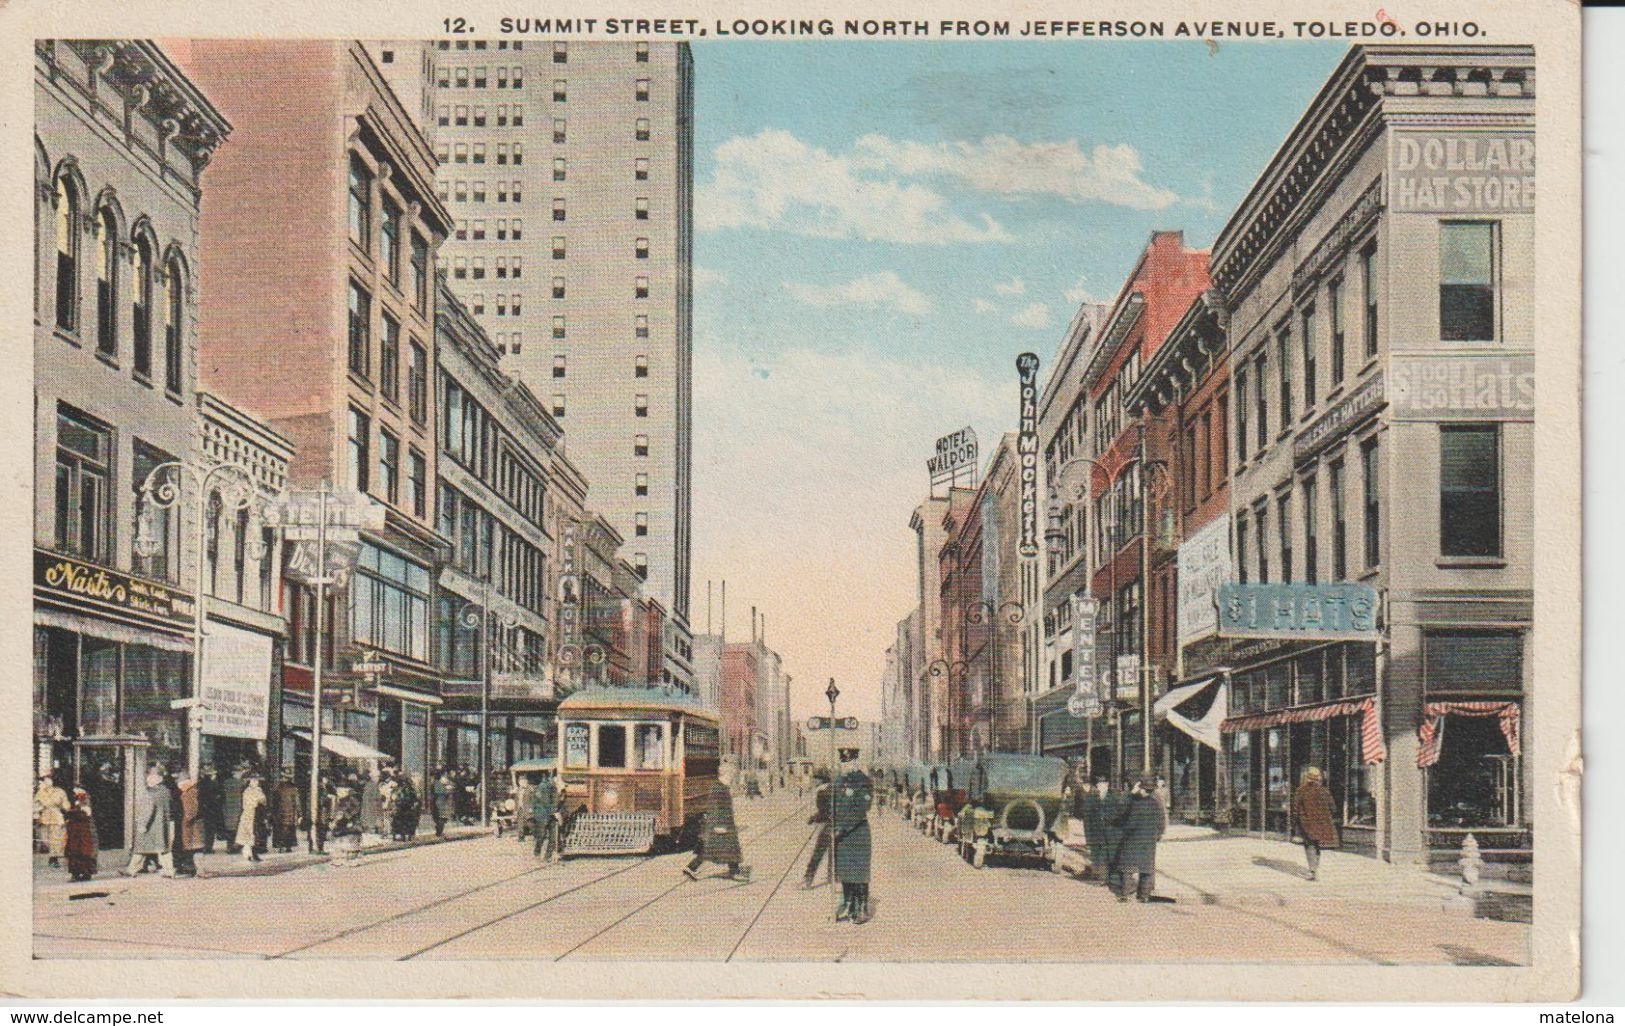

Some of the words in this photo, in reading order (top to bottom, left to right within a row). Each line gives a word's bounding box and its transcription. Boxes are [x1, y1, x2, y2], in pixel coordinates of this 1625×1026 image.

[443, 18, 475, 34] 12.
[500, 17, 597, 34] SUMMIT
[605, 18, 707, 37] STREET,
[716, 19, 833, 36] LOOKING
[844, 20, 929, 36] NORTH
[940, 20, 1010, 36] FROM
[1020, 20, 1164, 37] JEFFERSON
[1174, 21, 1284, 38] AVENUE,
[1415, 21, 1487, 38] OHIO.
[1396, 137, 1536, 171] DOLLAR
[1399, 176, 1450, 208] HAT
[1453, 176, 1536, 209] STORE
[1019, 355, 1038, 370] The
[1020, 369, 1036, 432] John
[1449, 360, 1536, 410] Hats
[936, 429, 969, 456] HOTEL
[1227, 590, 1258, 630] $1
[1271, 589, 1373, 632] HATS
[1078, 599, 1095, 694] MENTER
